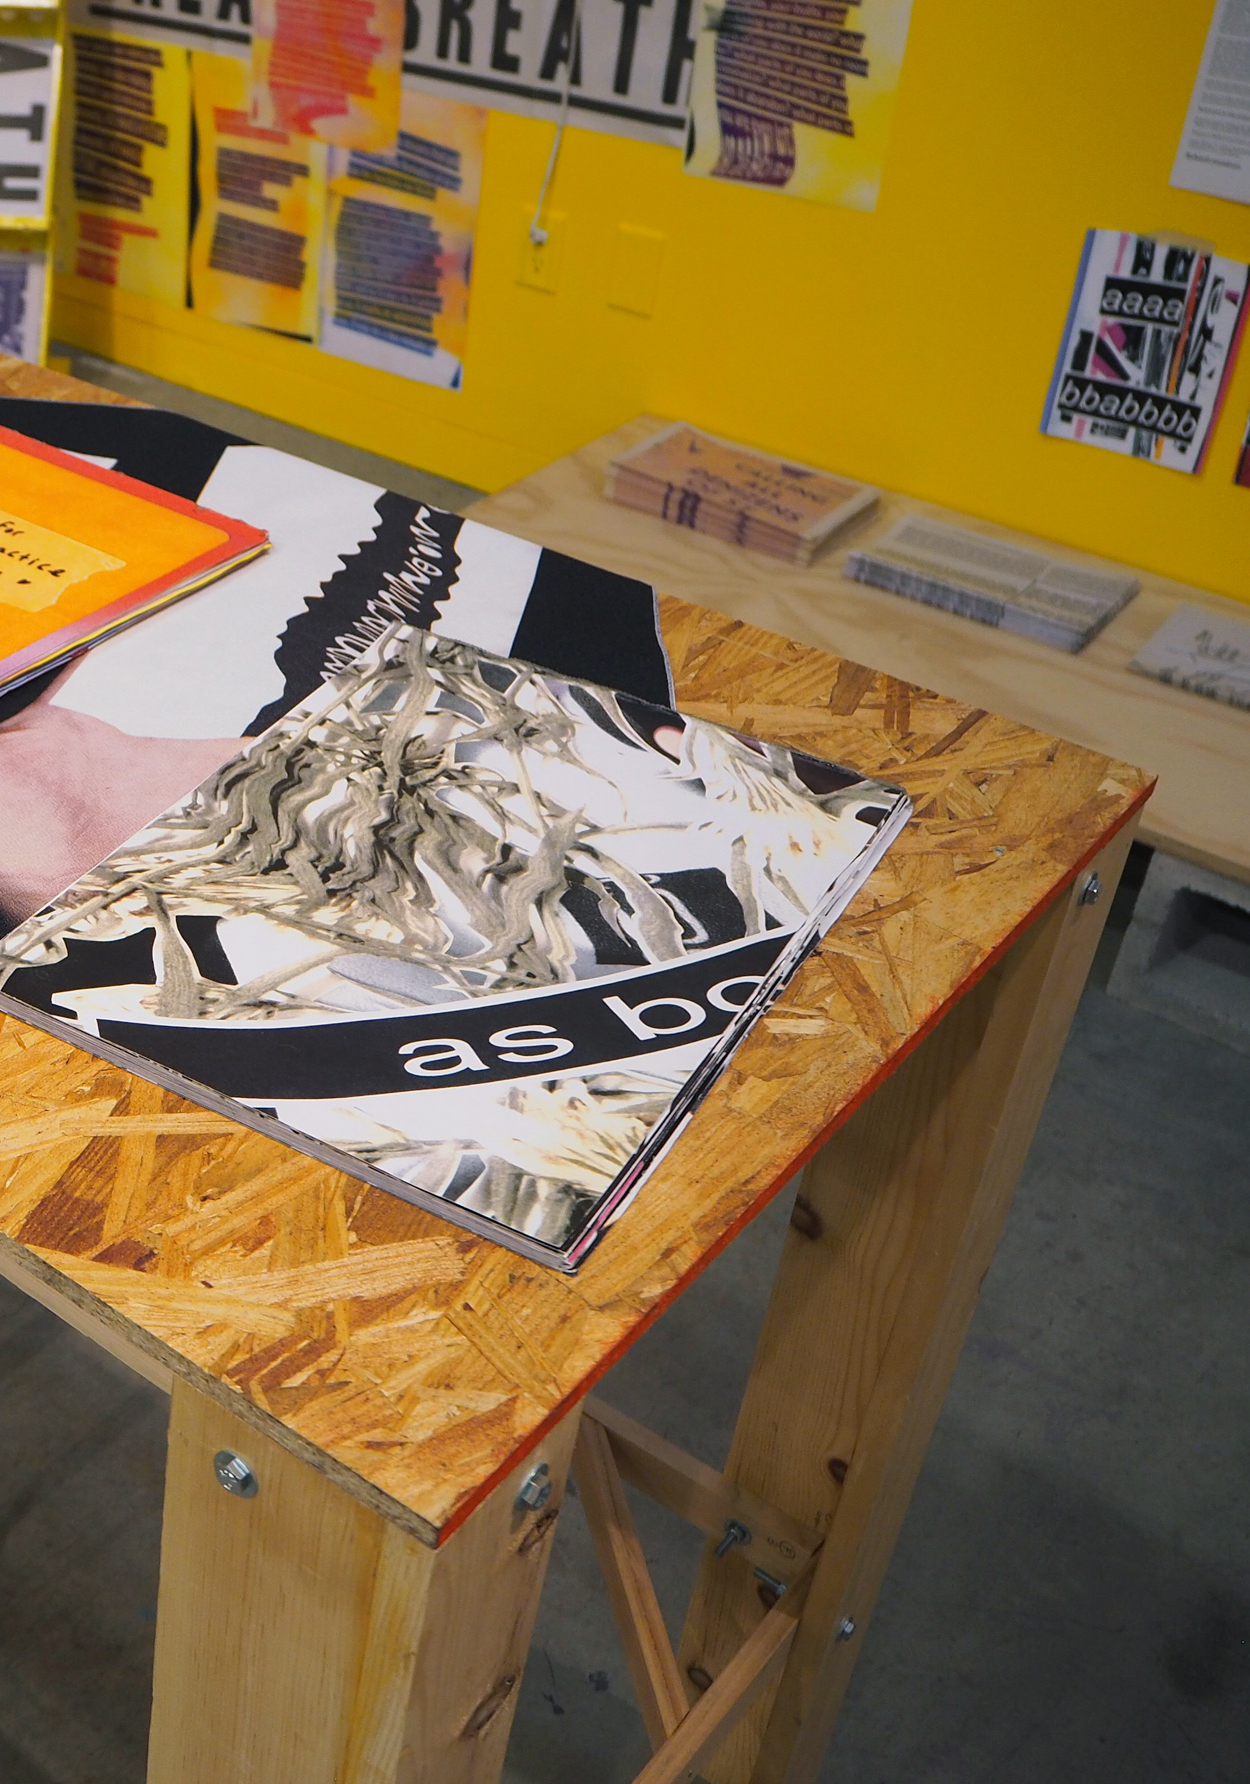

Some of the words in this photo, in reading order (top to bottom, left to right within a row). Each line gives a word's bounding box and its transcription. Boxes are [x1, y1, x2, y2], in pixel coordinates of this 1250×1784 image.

[1102, 288, 1184, 322] aaaa
[1059, 379, 1197, 438] bbabbbb
[398, 1023, 575, 1077] as
